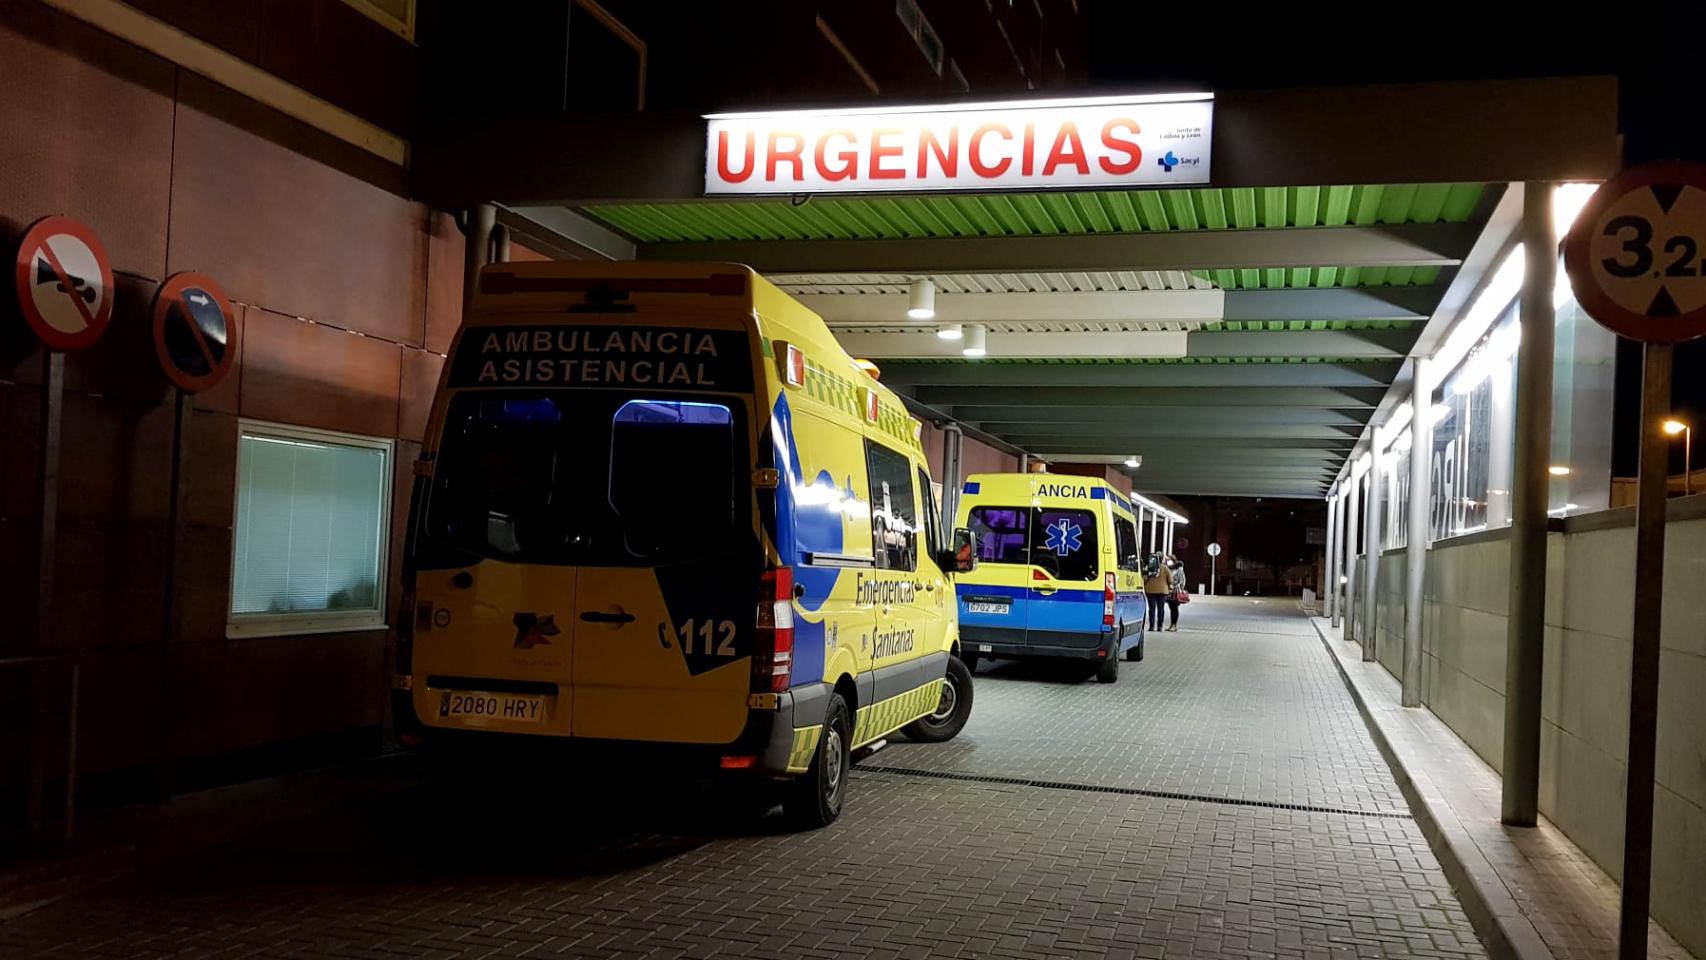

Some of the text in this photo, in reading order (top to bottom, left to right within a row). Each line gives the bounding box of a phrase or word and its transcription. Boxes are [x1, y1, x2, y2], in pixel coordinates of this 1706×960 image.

[717, 118, 1143, 183] URGENCIAS
[1602, 215, 1706, 278] 3.2
[481, 331, 718, 356] AMBULANCIA
[478, 359, 716, 385] ASISTENCIAL
[1037, 484, 1087, 499] ANCIA
[856, 572, 914, 614] Emergencias
[680, 618, 737, 656] 112
[870, 623, 914, 660] Sanitarias
[451, 695, 540, 719] 2080 HRY
